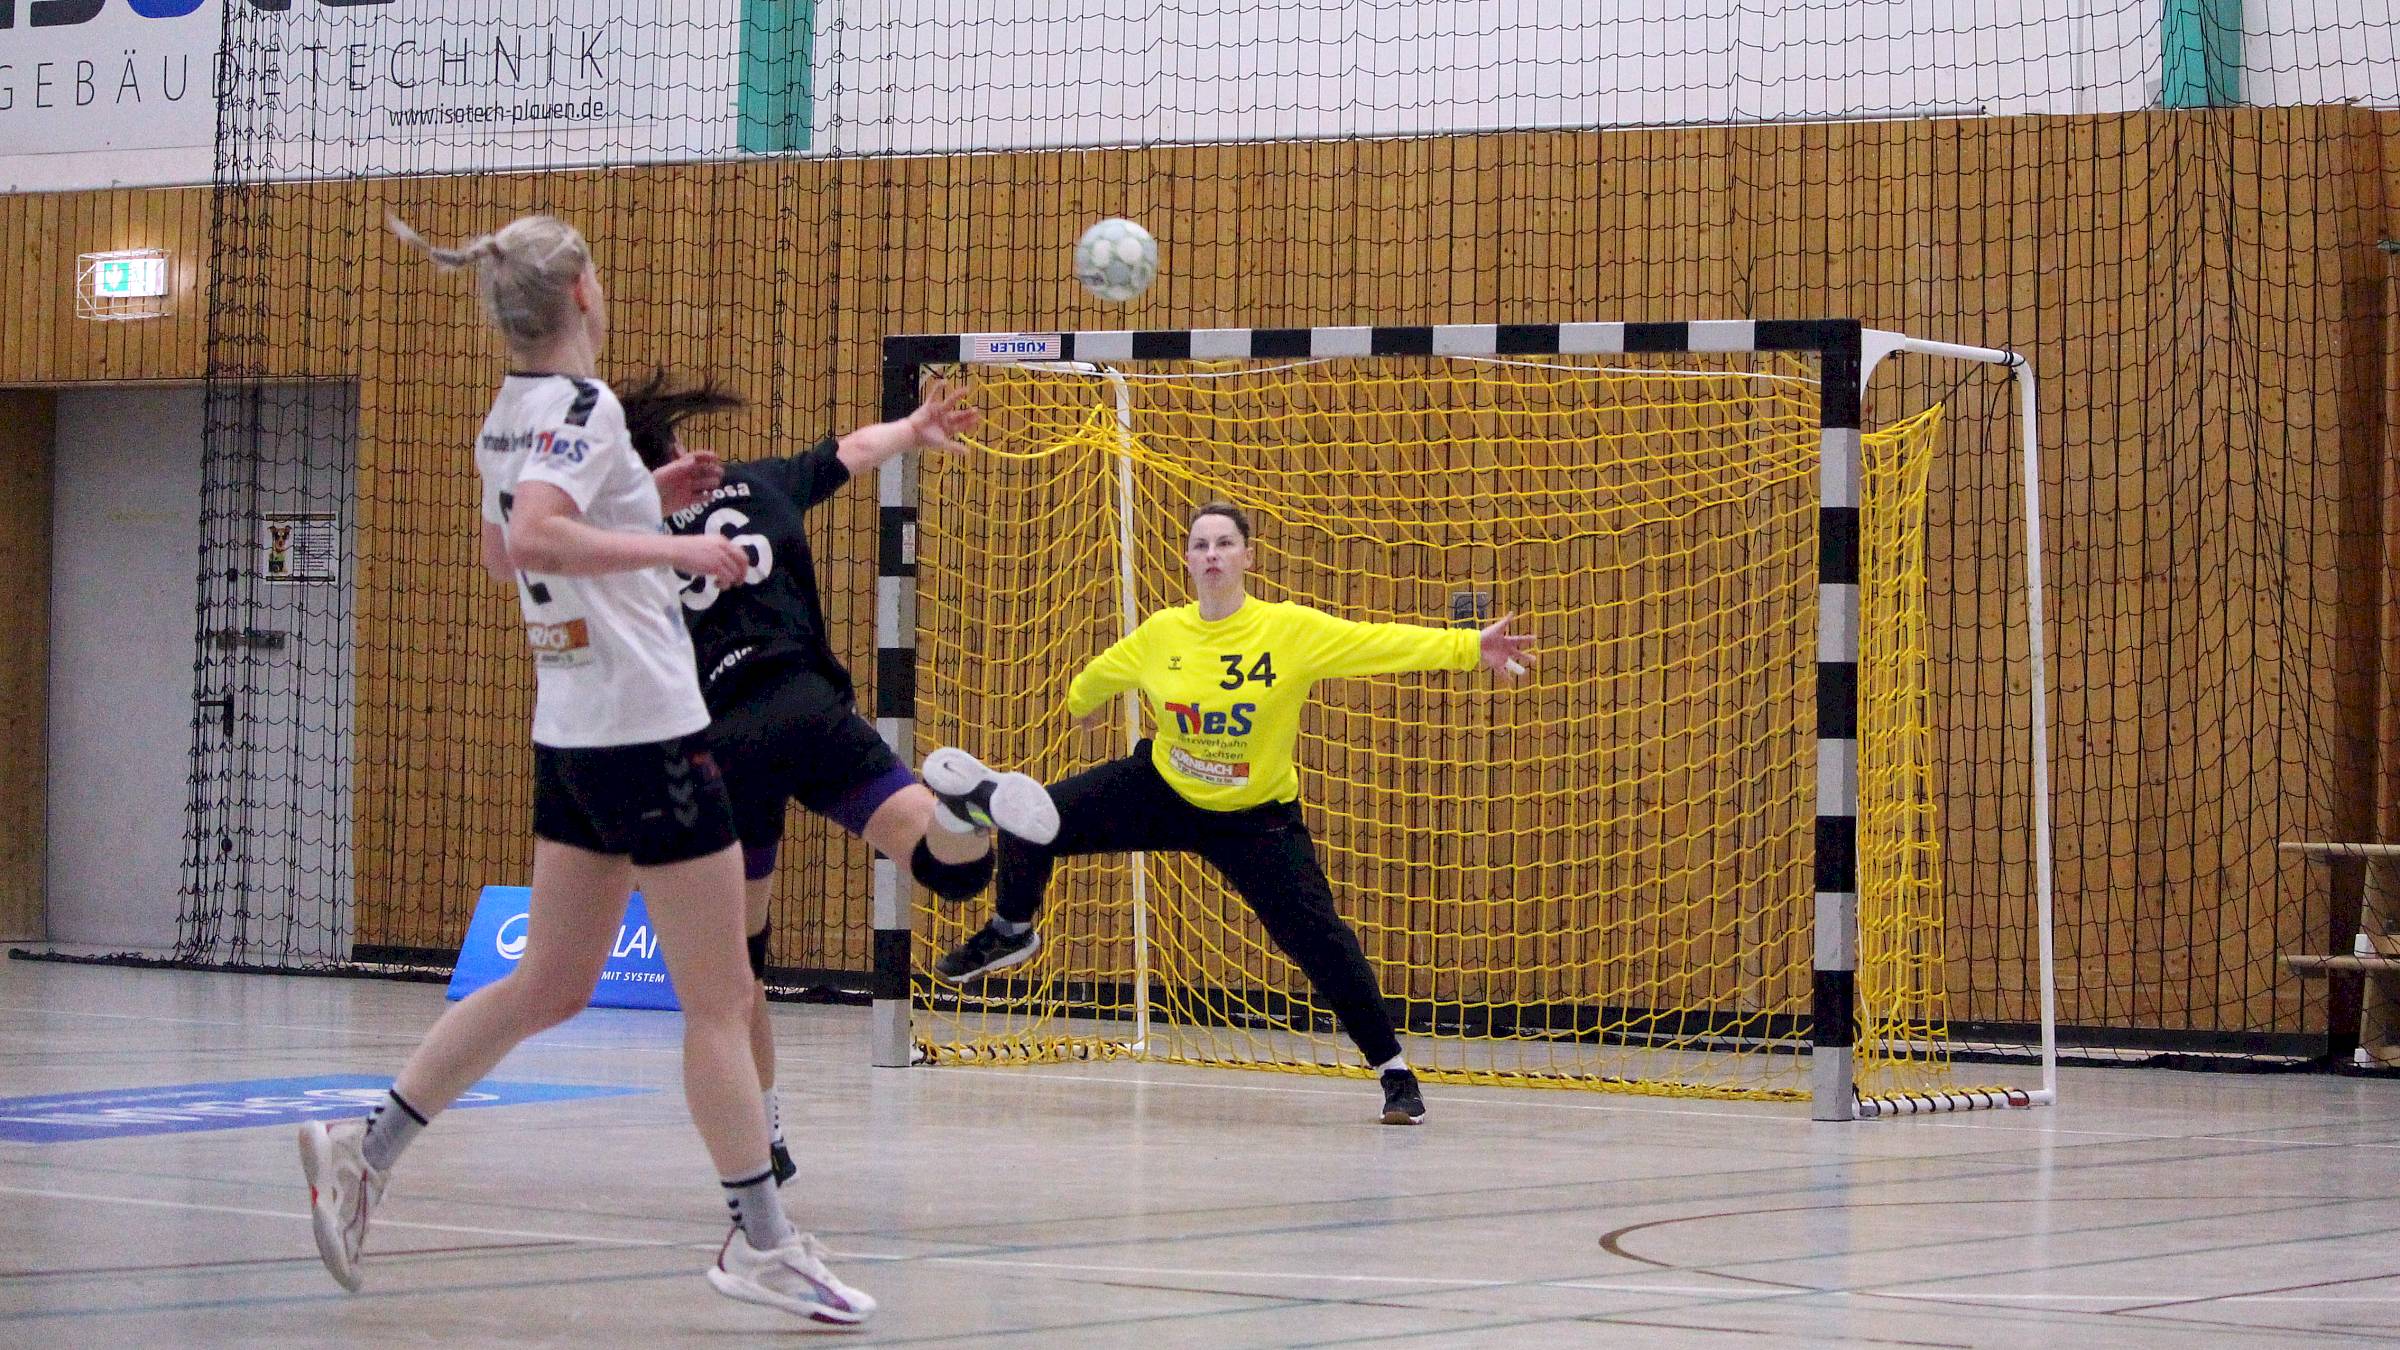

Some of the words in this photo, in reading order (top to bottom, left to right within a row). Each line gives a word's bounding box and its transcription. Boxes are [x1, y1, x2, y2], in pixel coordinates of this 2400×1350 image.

[389, 96, 604, 126] www.isotech-plauen.de
[990, 342, 1046, 355] KÜBLER
[1220, 652, 1276, 690] 34
[601, 971, 621, 982] MIT
[624, 972, 665, 983] SYSTEM
